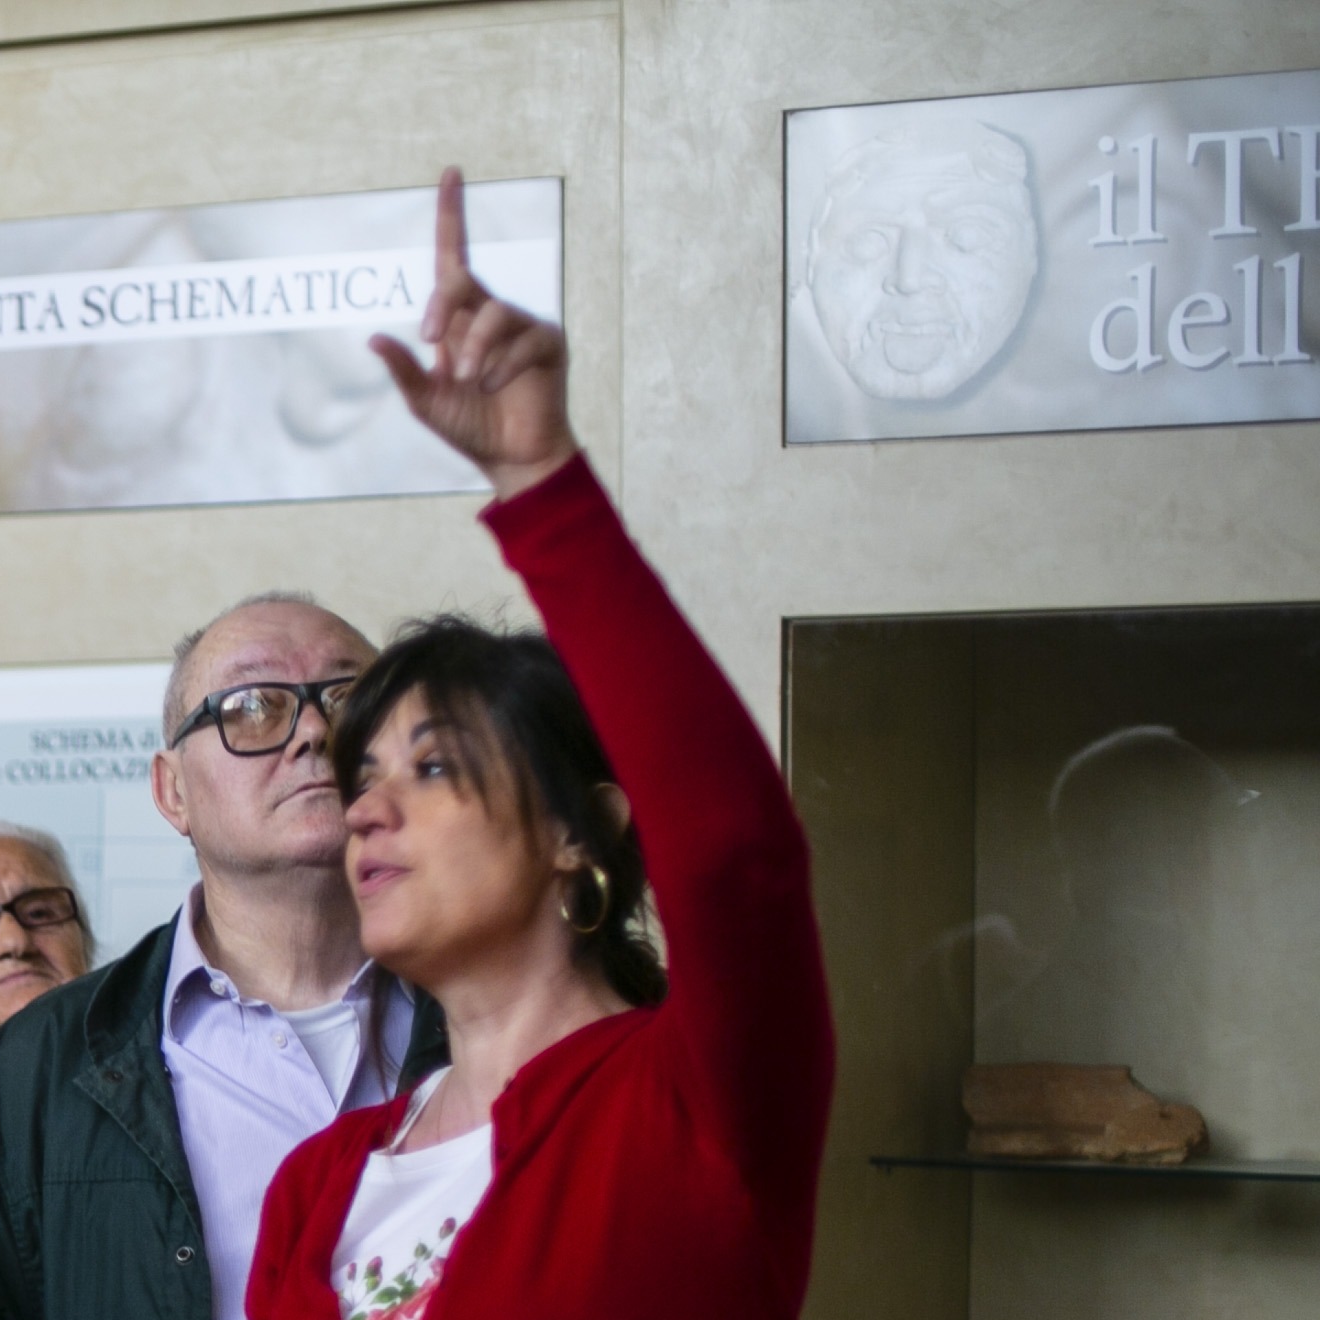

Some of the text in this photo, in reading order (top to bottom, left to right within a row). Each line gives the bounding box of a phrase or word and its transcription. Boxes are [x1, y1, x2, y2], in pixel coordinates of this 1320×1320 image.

[1088, 135, 1166, 247] il
[80, 266, 414, 329] SCHEMATICA
[1089, 253, 1311, 373] dell
[29, 729, 133, 754] SCHEMA
